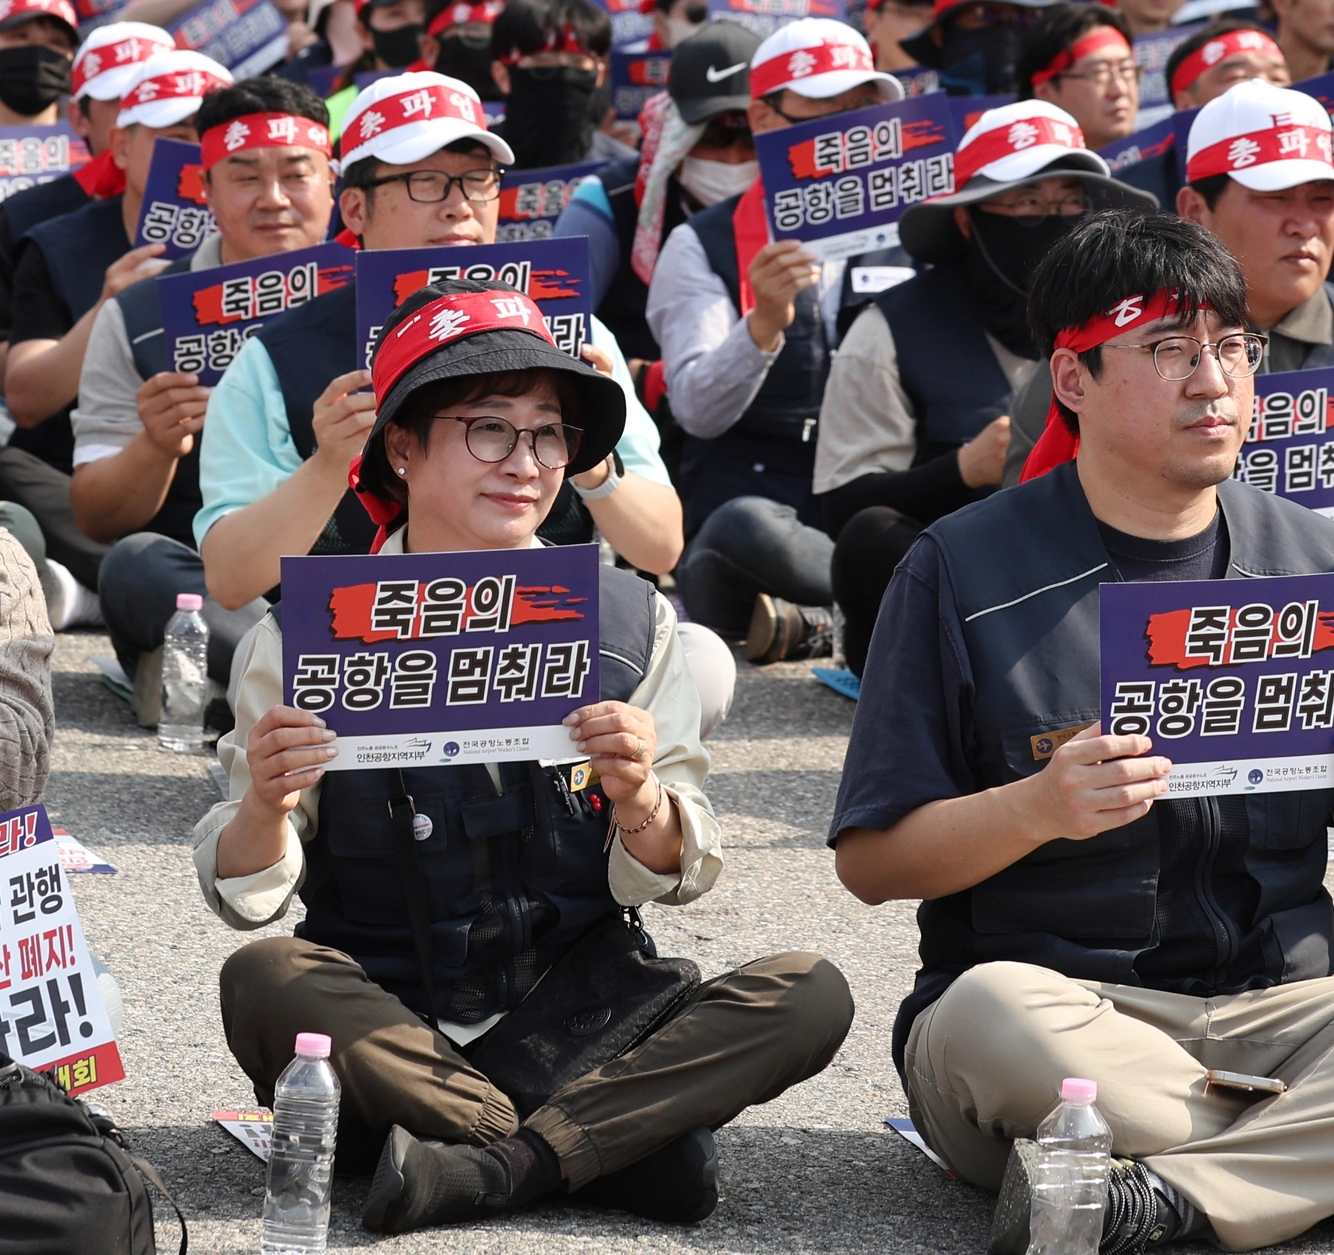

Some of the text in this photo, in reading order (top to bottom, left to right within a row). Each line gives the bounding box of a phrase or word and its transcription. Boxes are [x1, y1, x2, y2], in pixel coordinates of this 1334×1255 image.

[814, 117, 903, 174] 죽음의
[774, 152, 956, 233] 공항을 멈춰라
[221, 261, 319, 320] 죽음의
[369, 574, 516, 639] 죽음의
[1182, 599, 1320, 669] 죽음의
[291, 640, 592, 714] 공항을 멈춰라
[1108, 674, 1246, 739] 공항을
[356, 750, 426, 764] 인천공항지역지부
[1168, 778, 1232, 792] 인천공항지역지부
[9, 862, 64, 924] 관행
[19, 924, 77, 982] 폐지!
